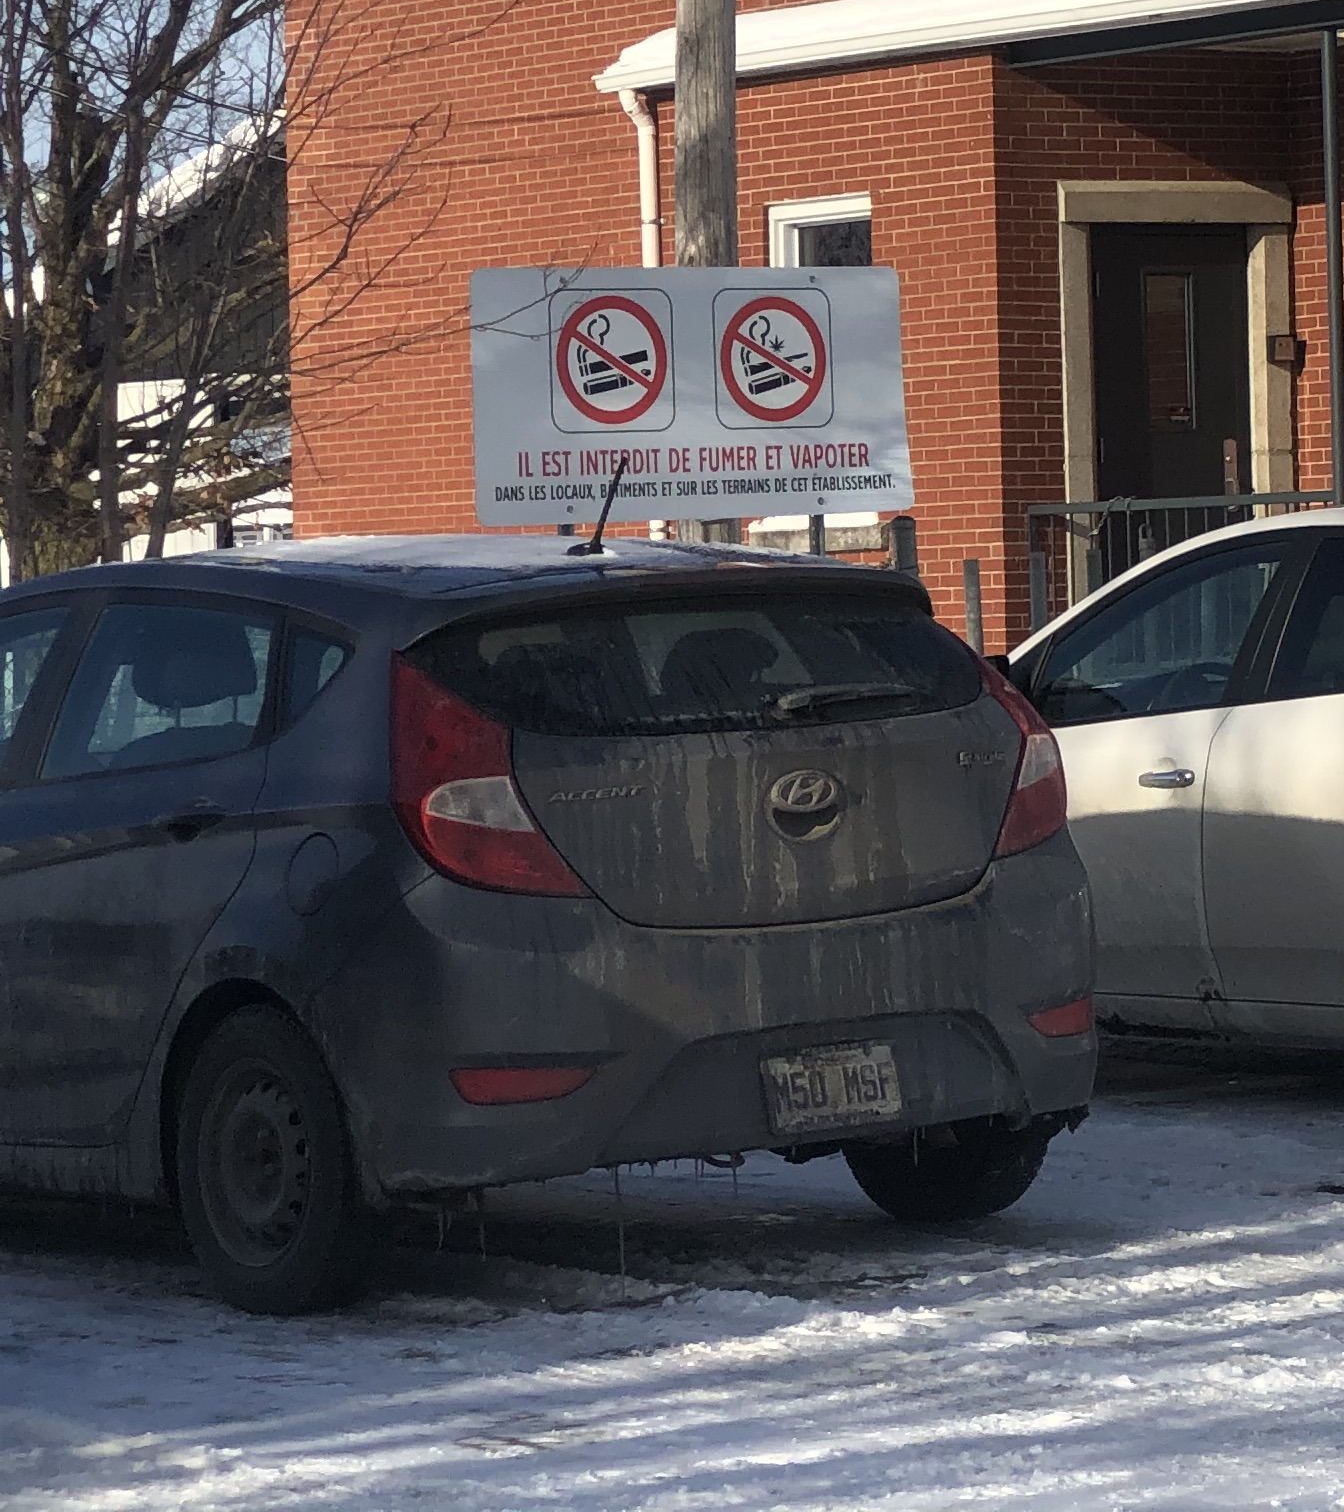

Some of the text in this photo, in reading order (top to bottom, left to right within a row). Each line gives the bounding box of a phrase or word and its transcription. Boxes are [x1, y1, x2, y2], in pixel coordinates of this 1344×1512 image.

[518, 443, 870, 477] IL EST INTERDIT DE FUMER ET VAPOTER
[495, 485, 525, 502] DANS
[529, 485, 546, 501] LES
[550, 483, 596, 502] LOCAUX,
[662, 482, 672, 496] ET
[676, 480, 698, 496] SUR
[701, 479, 718, 496] LES
[722, 477, 771, 495] TERRAINS
[774, 477, 788, 493] DE
[790, 477, 808, 492] CET
[812, 473, 896, 492] ÉTABLISSEMENT.
[547, 785, 643, 803] ACCENT
